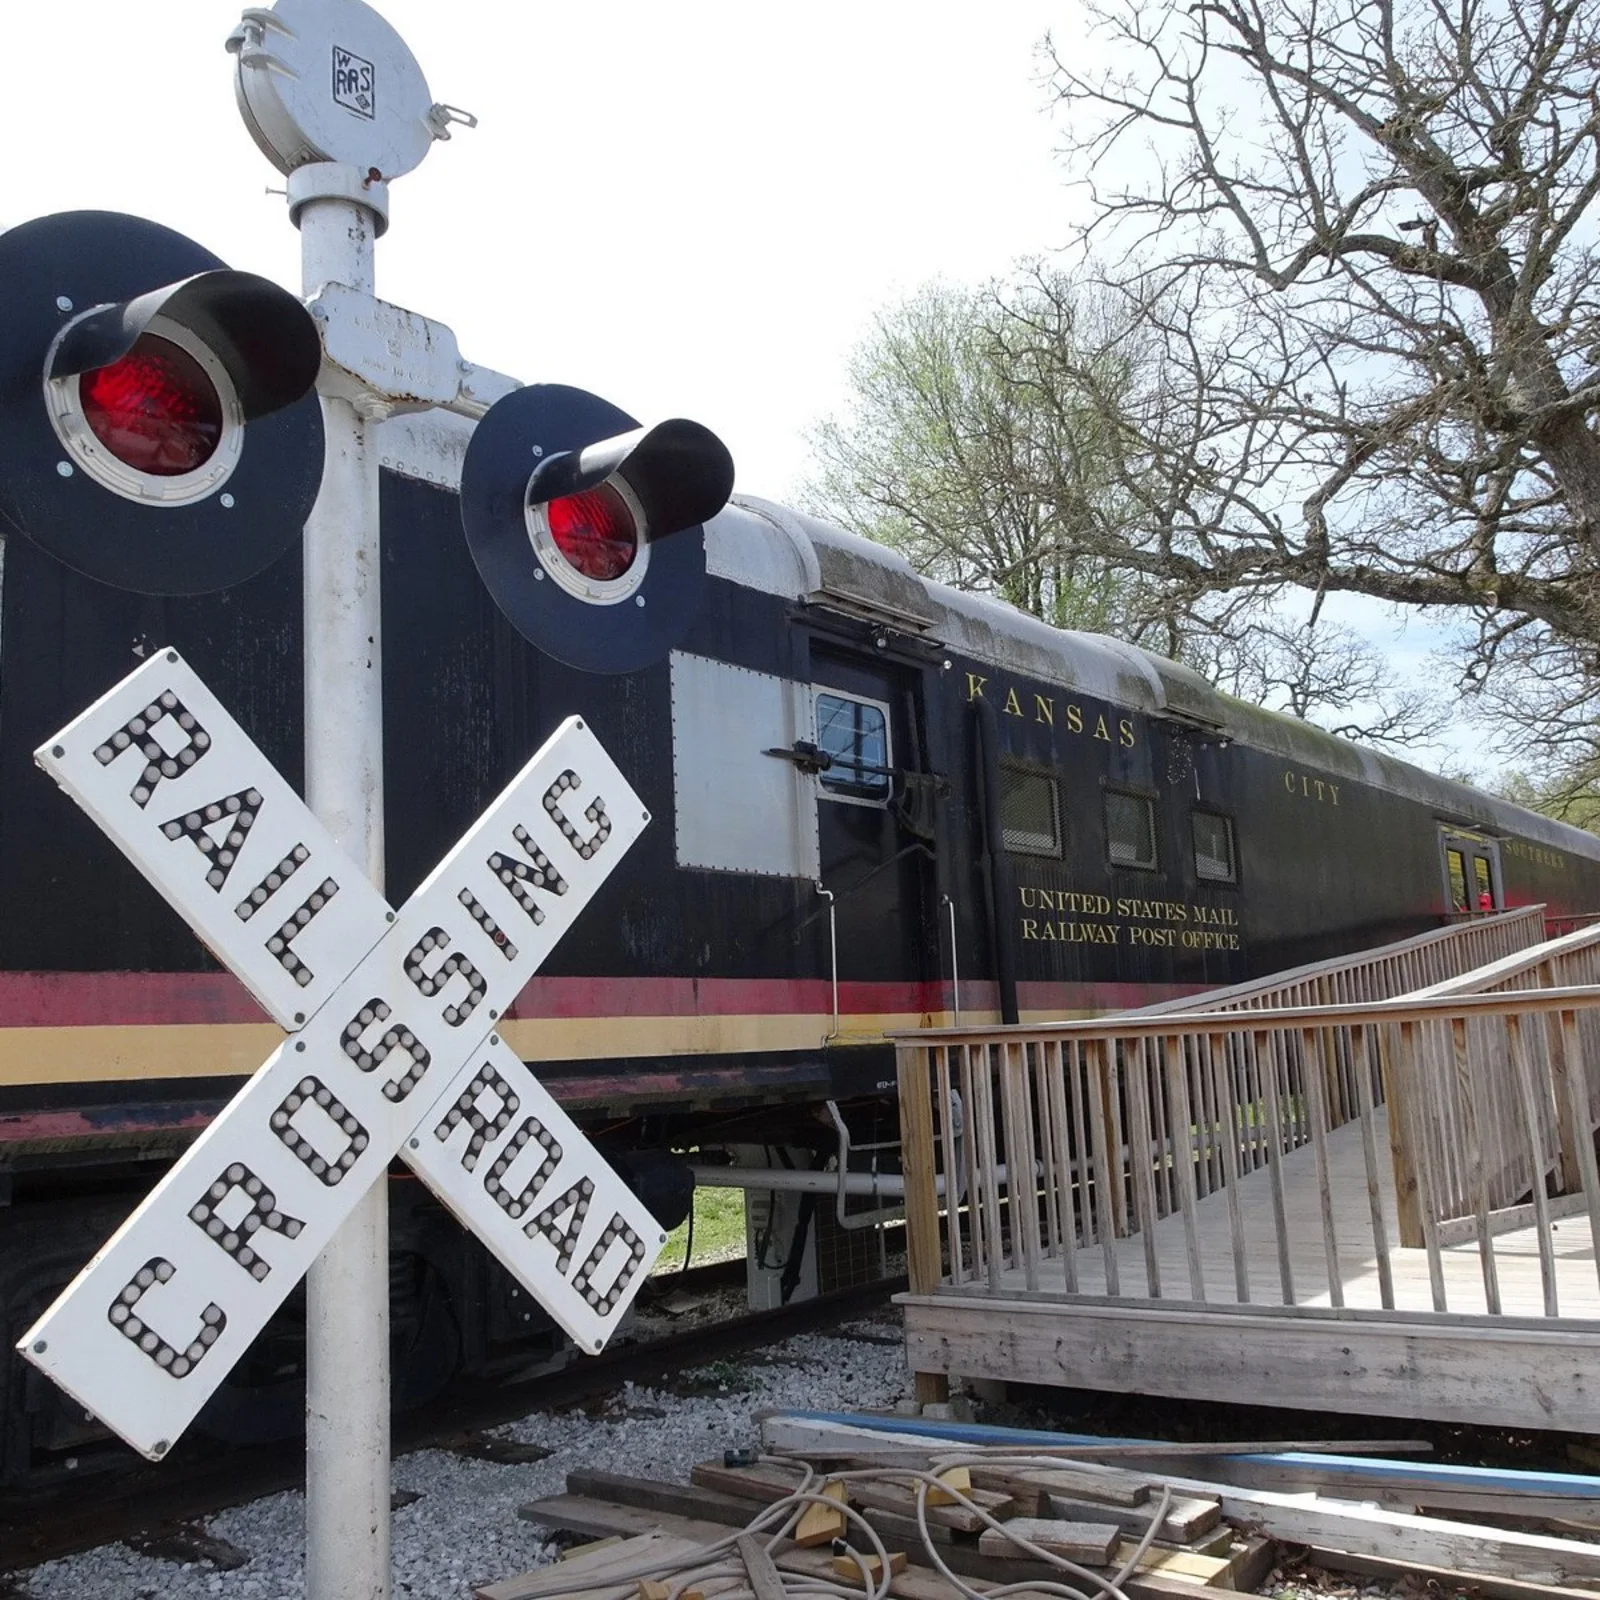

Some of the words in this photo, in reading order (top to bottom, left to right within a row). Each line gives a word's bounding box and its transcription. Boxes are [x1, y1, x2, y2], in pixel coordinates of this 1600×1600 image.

[965, 672, 1135, 747] KANSAS
[1285, 771, 1340, 805] CITY
[1019, 887, 1111, 916] UNITED
[1116, 898, 1188, 921] STATES
[1193, 905, 1239, 926] MAIL
[1021, 919, 1120, 945] RAILWAY
[1129, 926, 1177, 946] POST
[1181, 930, 1240, 951] OFFICE
[92, 688, 340, 988] RAIL
[433, 1060, 647, 1317] ROAD
[107, 768, 613, 1380] CROSSING
